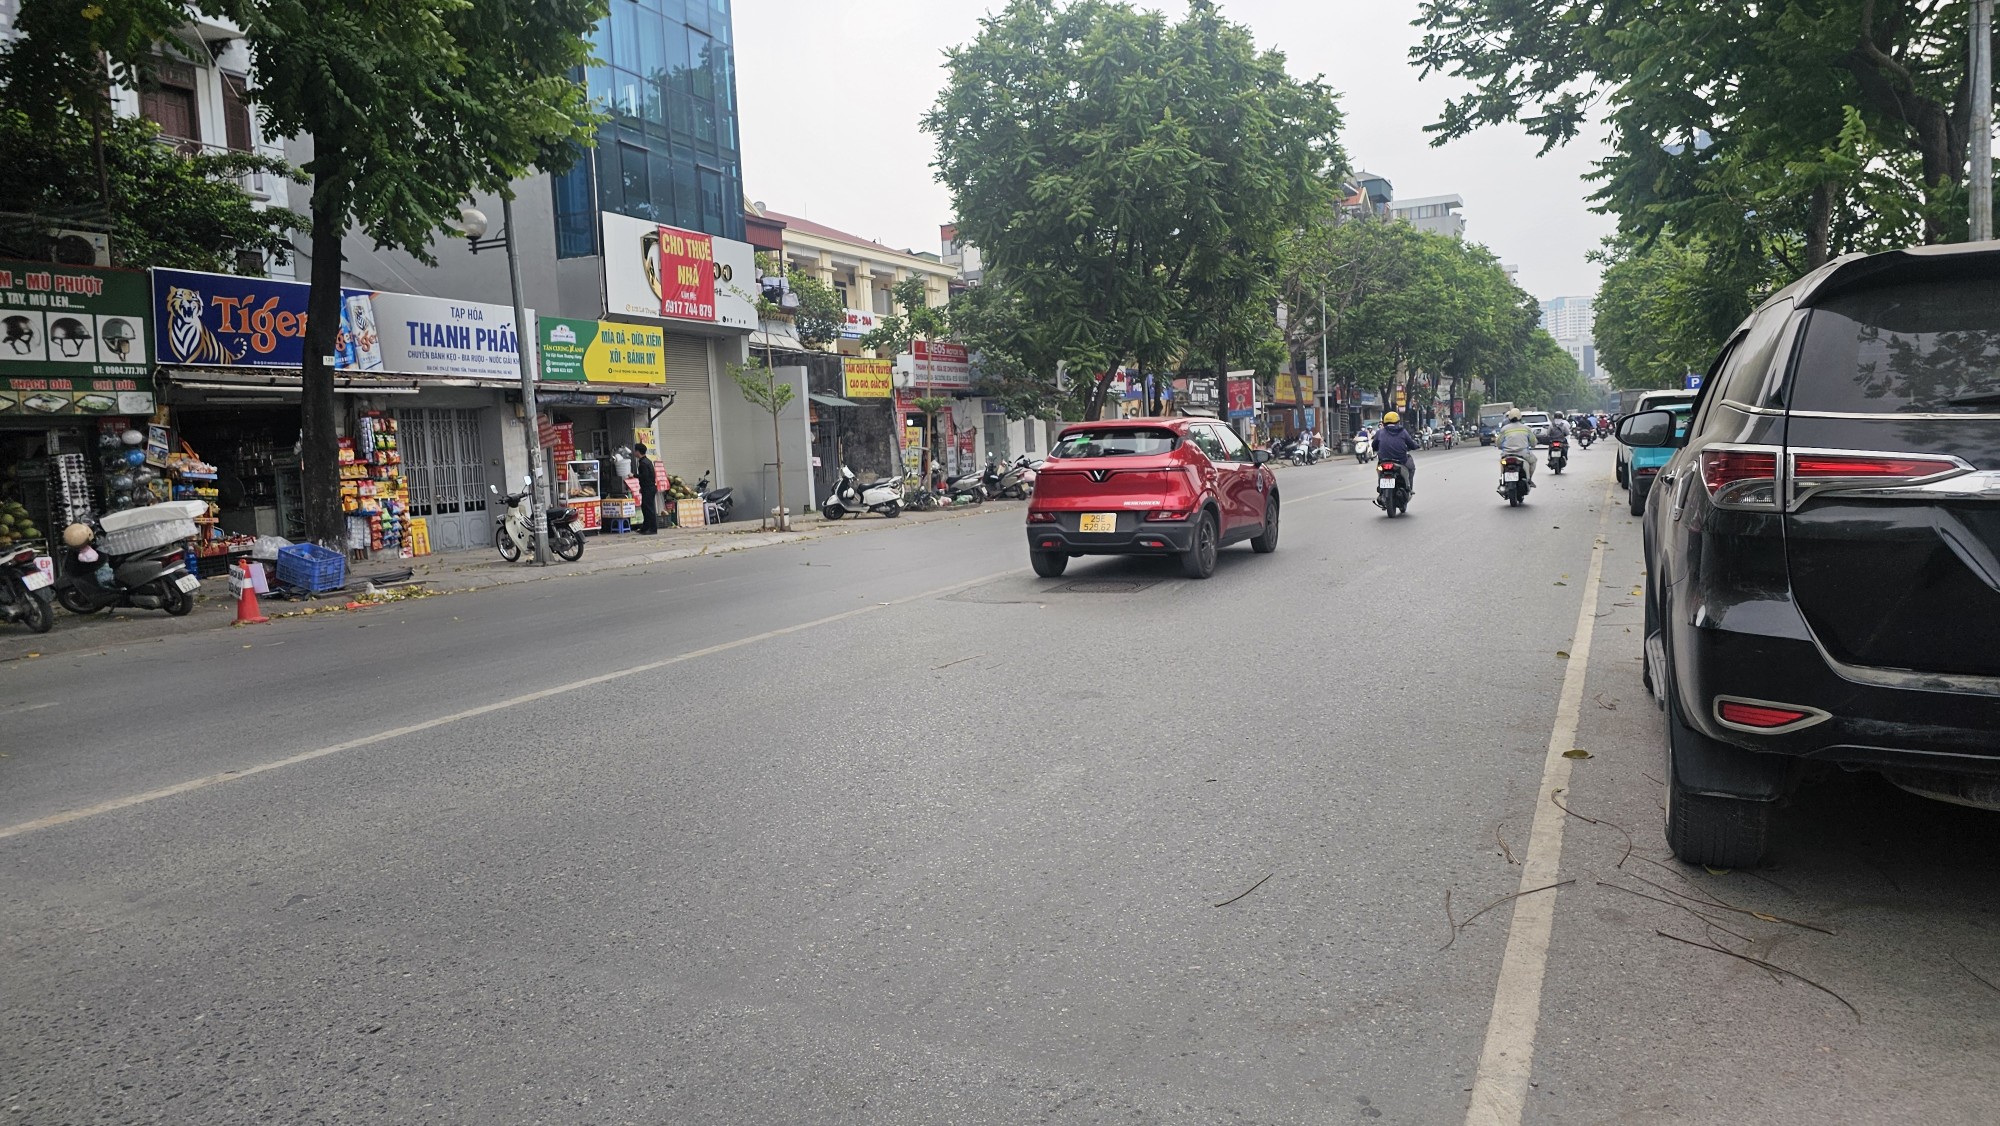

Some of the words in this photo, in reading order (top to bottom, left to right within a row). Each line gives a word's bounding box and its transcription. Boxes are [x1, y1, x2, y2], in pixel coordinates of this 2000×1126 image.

[662, 233, 684, 257] CHO
[685, 238, 712, 262] THUÊ
[26, 271, 51, 291] MŨ
[54, 274, 103, 298] PHƯỢT
[677, 263, 700, 287] NHÀ
[450, 306, 465, 322] TẠP
[467, 306, 484, 322] HÓA
[665, 299, 683, 315] 0917
[684, 301, 698, 316] 744
[699, 302, 713, 318] 879
[211, 294, 309, 354] Tiger
[406, 320, 471, 350] THANH
[601, 328, 615, 344] MÍA
[616, 329, 626, 345] ĐÁ
[631, 330, 645, 346] DỪA
[646, 332, 662, 347] XIÊM
[407, 350, 430, 360] CHUYÊN
[430, 351, 445, 360] BÁNH
[446, 352, 457, 362] KẸO
[461, 353, 470, 362] BIA
[471, 354, 485, 364] RƯỢU
[609, 347, 621, 363] XÔI
[627, 349, 645, 365] BÁNH
[1691, 377, 1700, 388] P
[1083, 523, 1111, 531] 529.62
[1090, 514, 1106, 523] 29E
